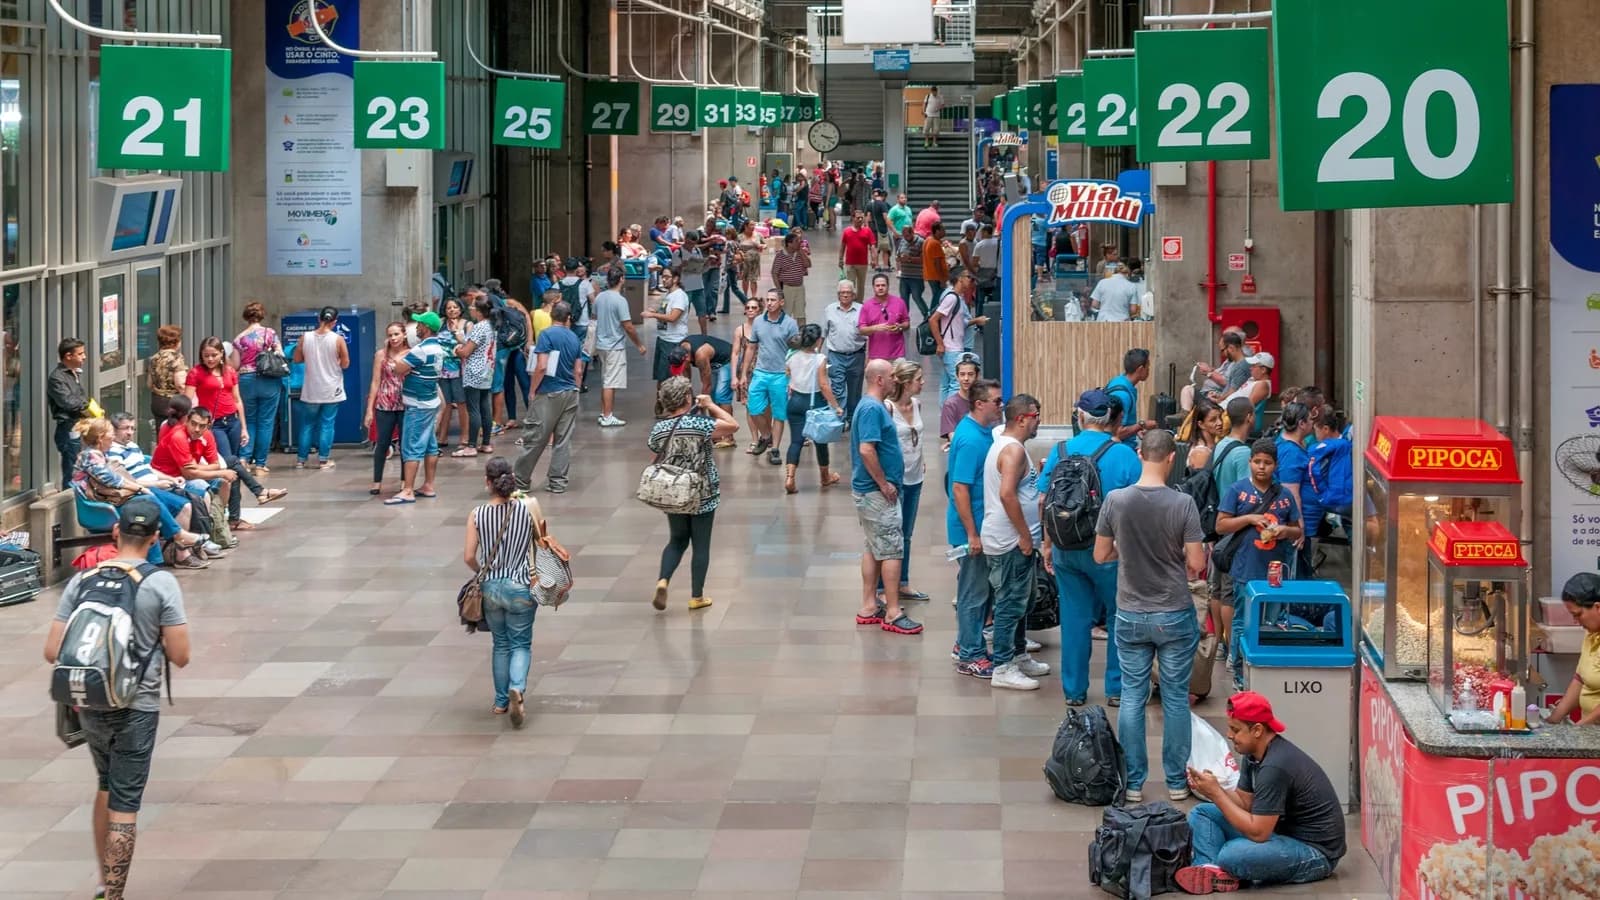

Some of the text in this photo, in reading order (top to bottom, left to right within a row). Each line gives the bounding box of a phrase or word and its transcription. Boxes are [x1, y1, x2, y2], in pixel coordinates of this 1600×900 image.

[366, 96, 430, 140] 23
[503, 106, 552, 141] 25
[592, 103, 631, 130] 27
[656, 103, 690, 127] 29
[703, 103, 730, 124] 31
[735, 104, 756, 122] 33
[1157, 81, 1251, 147] 22
[121, 95, 202, 157] 21
[1316, 68, 1480, 183] 20
[1070, 184, 1119, 203] Via
[1051, 199, 1141, 223] Mundi
[1412, 448, 1499, 468] PIPOCA
[1572, 514, 1586, 524] Só
[1456, 544, 1517, 558] PIPOCA
[1284, 681, 1322, 694] LIXO
